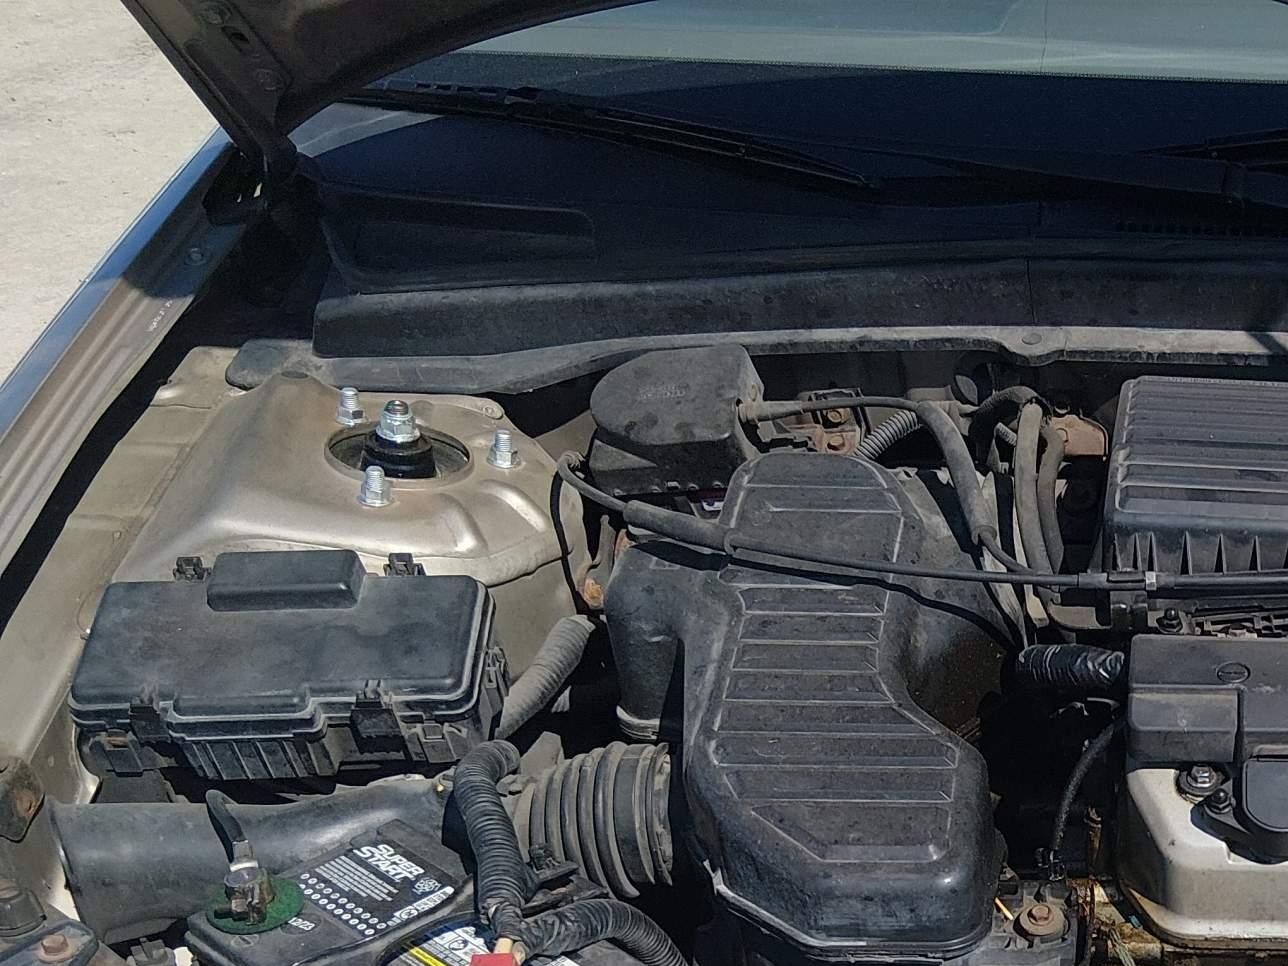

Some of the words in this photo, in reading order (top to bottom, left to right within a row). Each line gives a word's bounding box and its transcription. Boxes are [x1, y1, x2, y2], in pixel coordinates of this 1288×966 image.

[352, 846, 416, 882] START
[376, 843, 425, 876] SUPER
[288, 917, 316, 931] 12/23
